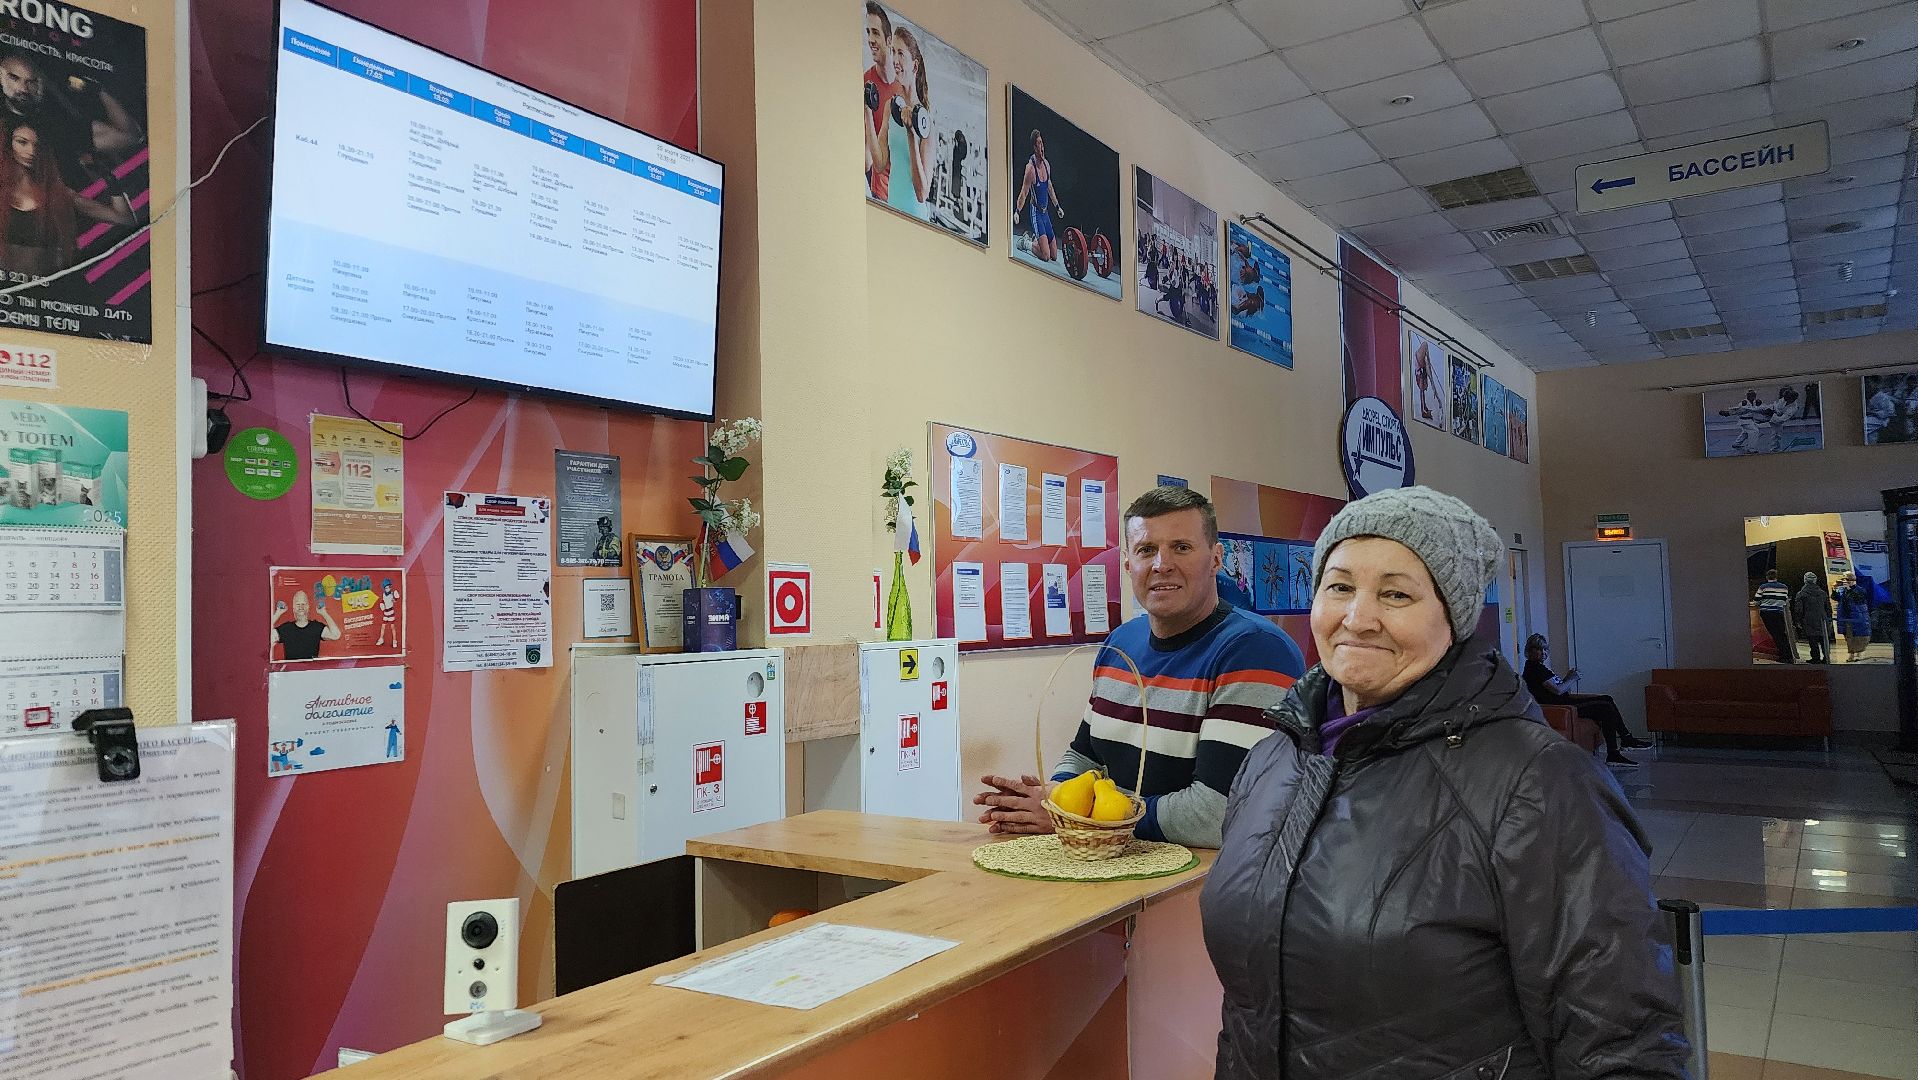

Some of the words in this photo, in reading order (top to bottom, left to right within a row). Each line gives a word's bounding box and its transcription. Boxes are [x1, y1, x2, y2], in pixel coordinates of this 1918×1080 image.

[290, 36, 331, 59] Помещение
[1668, 143, 1795, 183] БАССЕЙН
[17, 296, 36, 309] ТЫ
[41, 299, 100, 317] МОЖЕШЬ
[104, 308, 133, 321] ДАТЬ
[44, 315, 80, 332] ТЕЛУ
[16, 352, 51, 368] 112
[1382, 415, 1400, 433] СПОРТА
[16, 431, 73, 447] TOTEM
[1362, 421, 1401, 462] ИМПУЛЬС
[345, 463, 372, 478] 112
[566, 466, 602, 474] УЧАСТНИКОВ
[569, 459, 598, 469] ГАРАНТИИ
[83, 509, 121, 523] 2025
[649, 574, 684, 582] ГРАМОТА
[708, 614, 730, 622] ЗИМА
[305, 693, 373, 709] Активное
[304, 706, 374, 720] долголетие
[713, 783, 720, 793] 3
